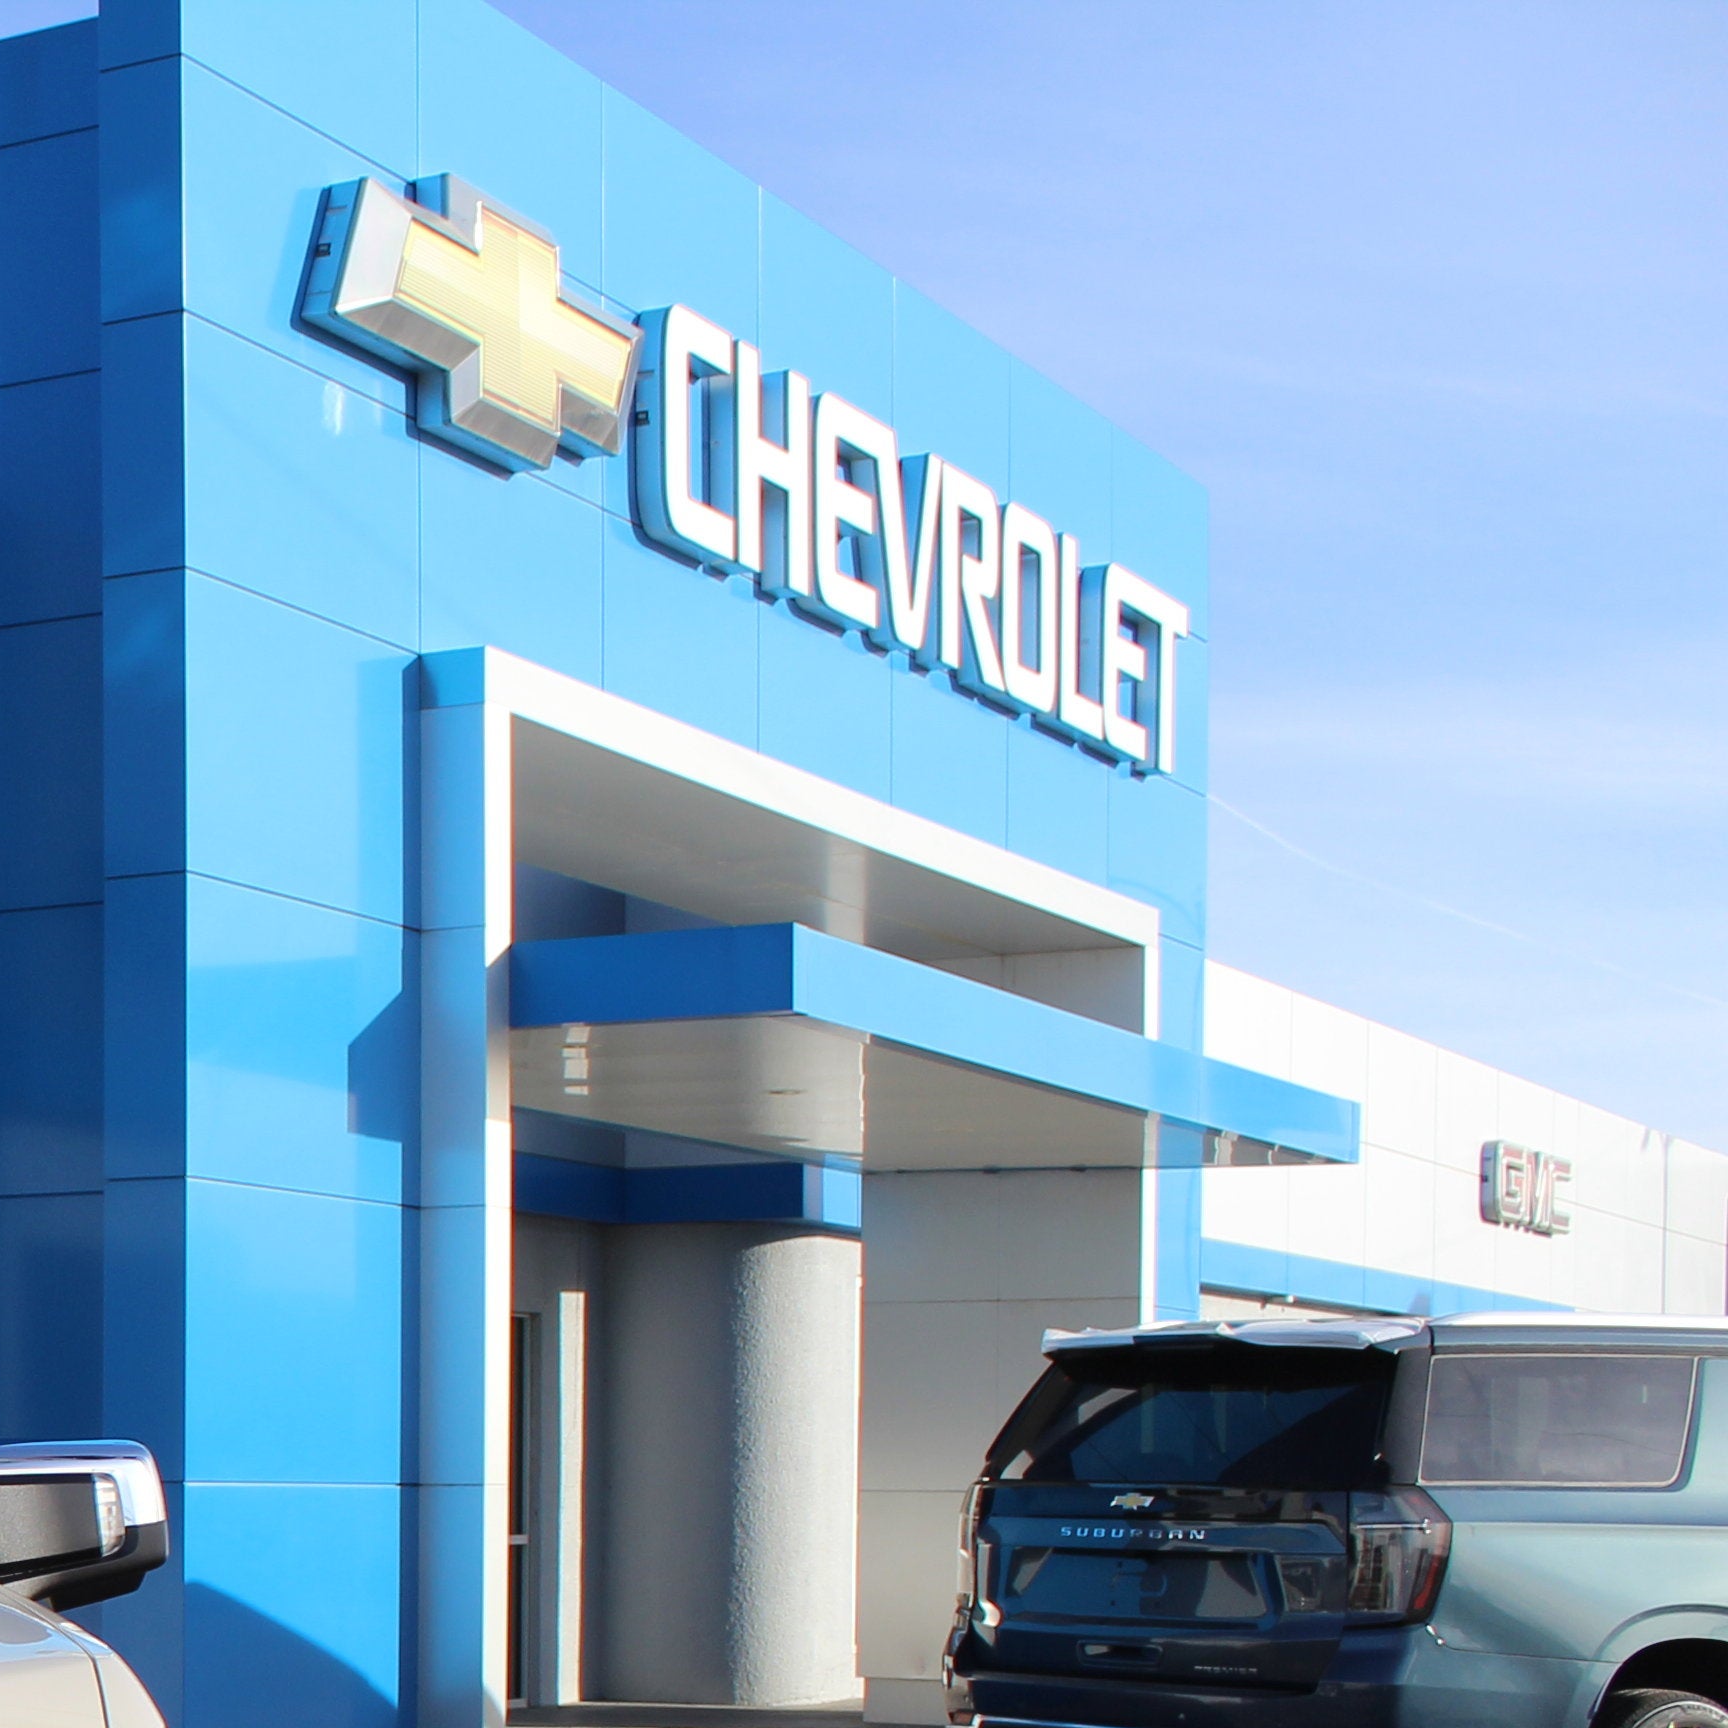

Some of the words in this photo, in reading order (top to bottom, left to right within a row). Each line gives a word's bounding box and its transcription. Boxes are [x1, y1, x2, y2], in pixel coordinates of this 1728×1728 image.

[630, 303, 1189, 778] CHEVROLET
[1482, 1140, 1572, 1236] GMC
[1060, 1526, 1205, 1540] SUBURBAN
